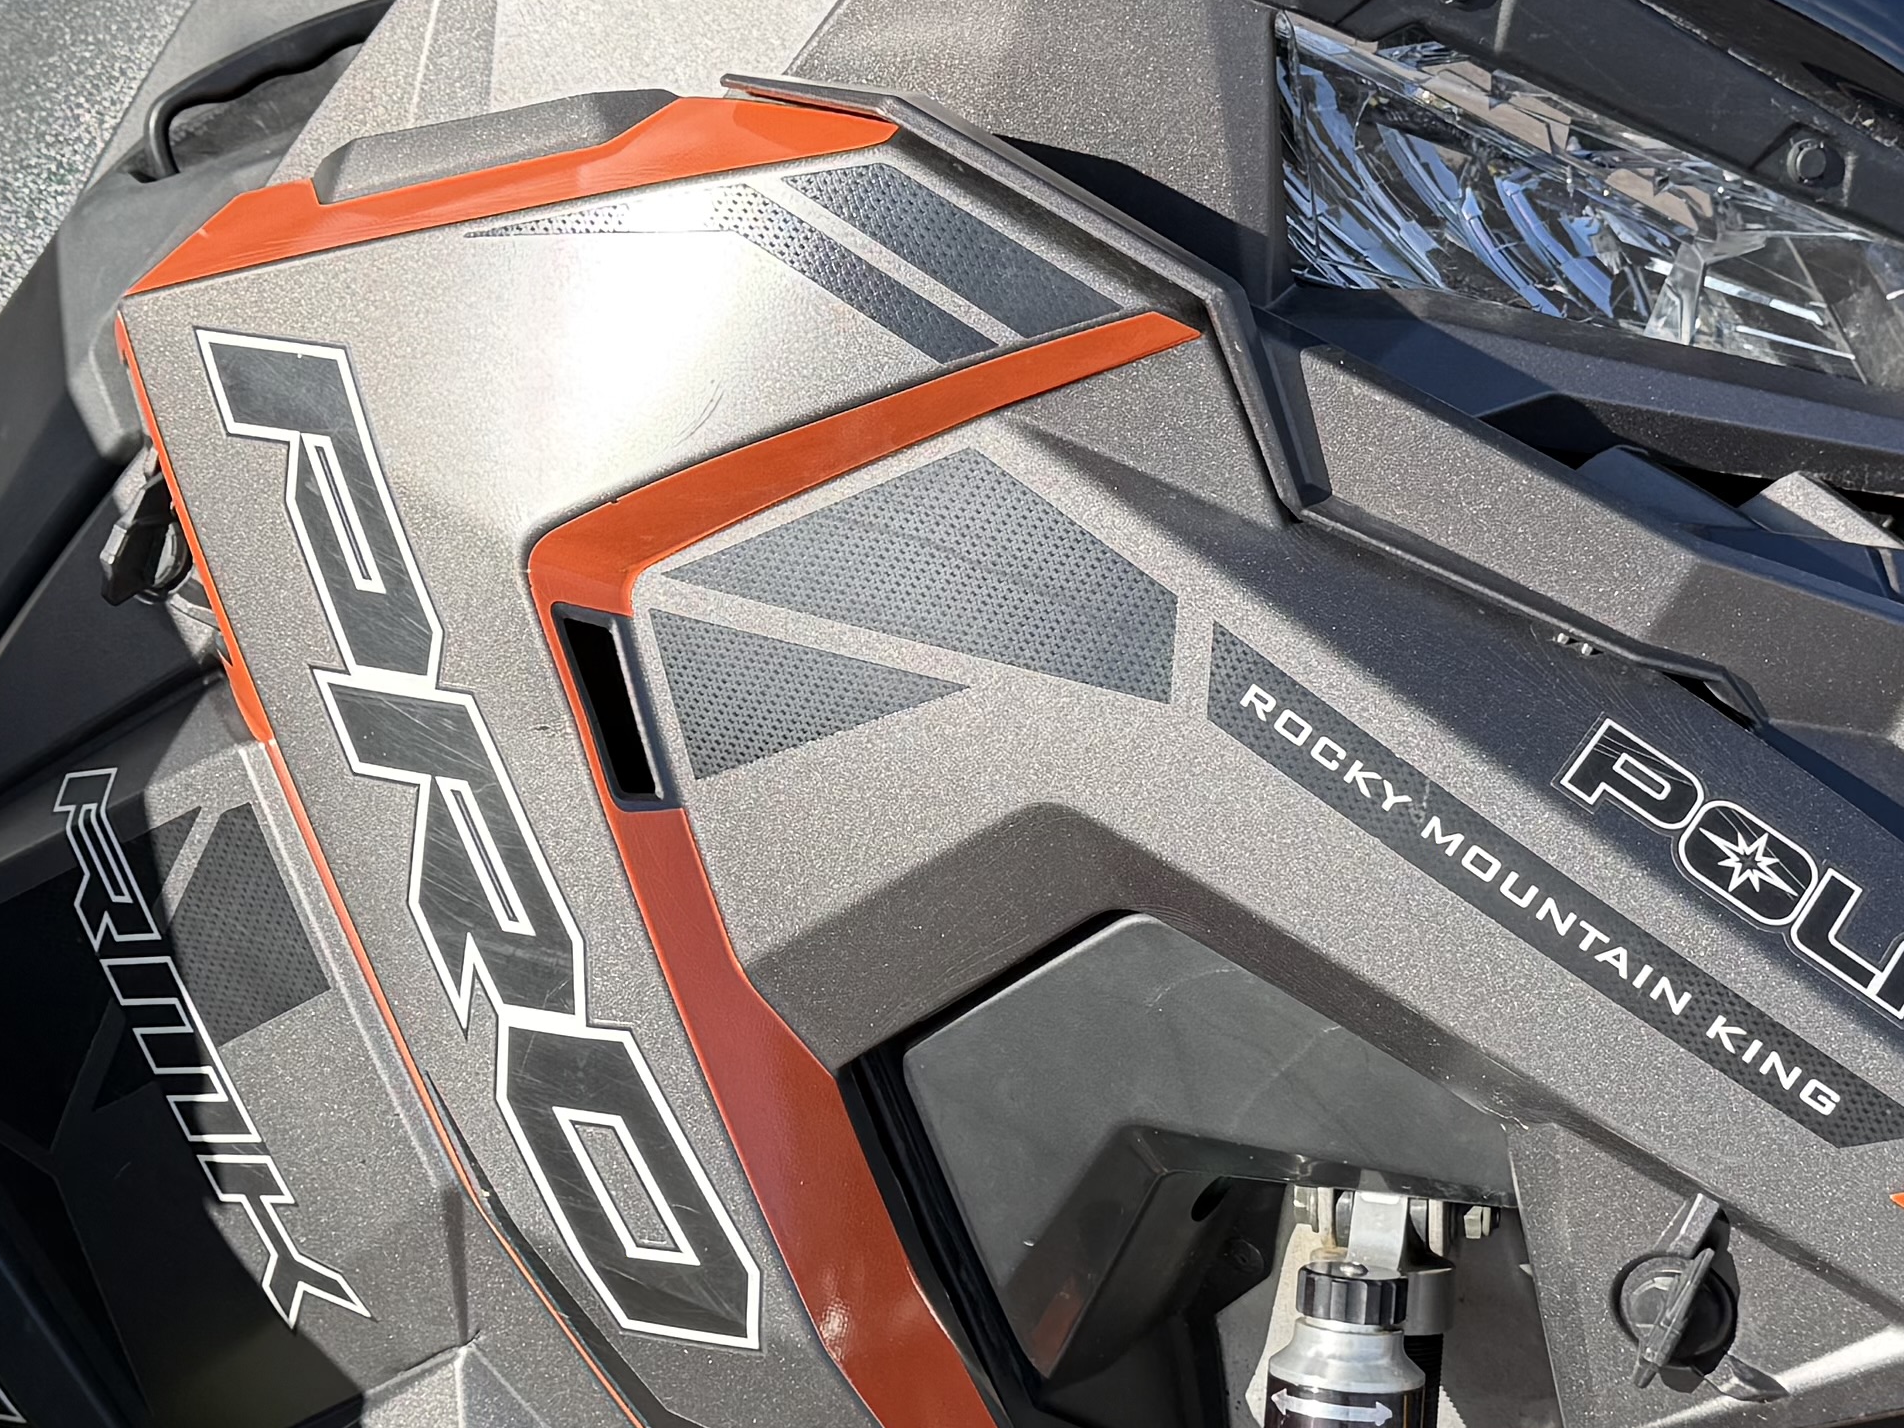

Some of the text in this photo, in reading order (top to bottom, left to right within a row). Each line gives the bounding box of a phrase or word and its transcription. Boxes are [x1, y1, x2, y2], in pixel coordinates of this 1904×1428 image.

[52, 767, 375, 1329] RMK
[193, 325, 764, 1352] PRO
[1239, 682, 1843, 1116] ROCKY MOUNTAIN KING
